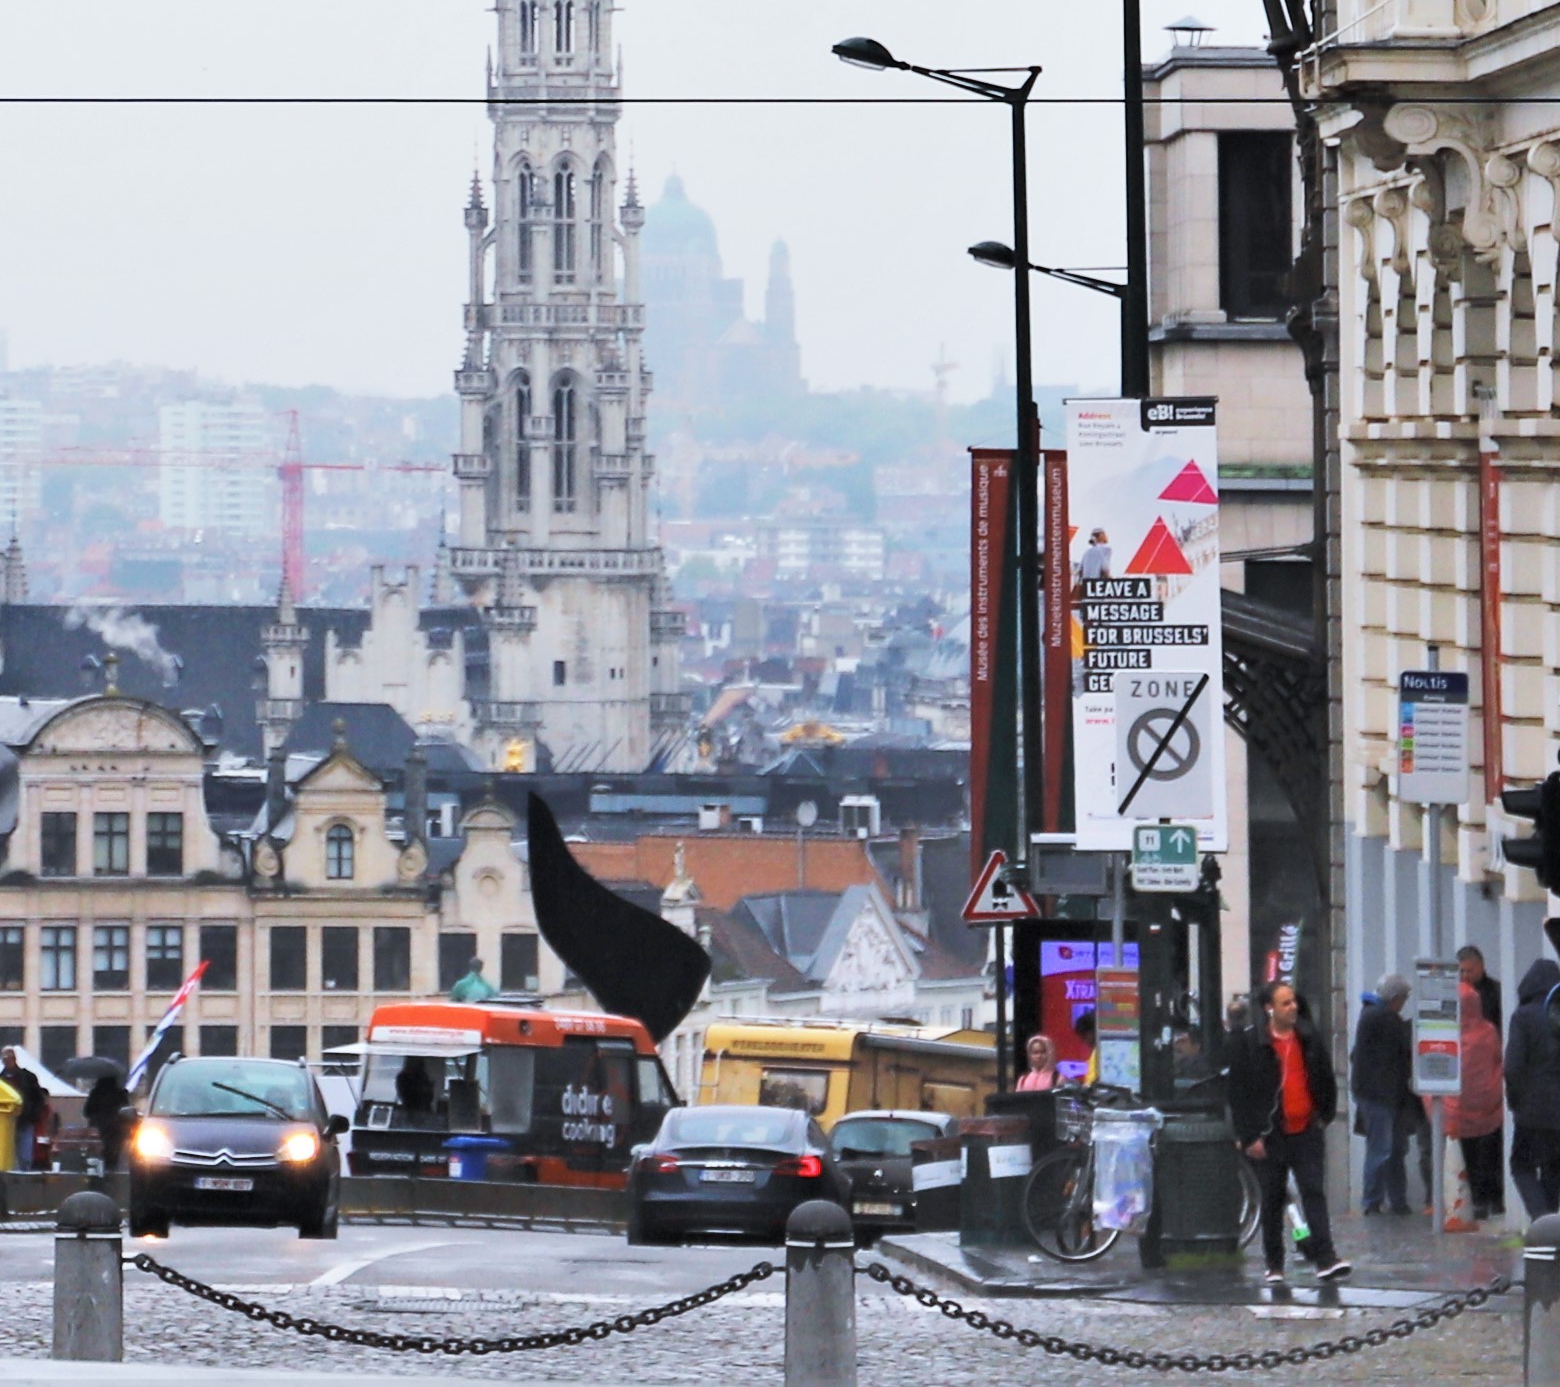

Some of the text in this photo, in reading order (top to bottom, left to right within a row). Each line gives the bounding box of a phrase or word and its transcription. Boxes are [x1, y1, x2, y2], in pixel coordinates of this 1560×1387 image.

[978, 464, 989, 518] musique
[977, 520, 989, 537] de
[977, 539, 989, 614] instruments
[1086, 581, 1147, 597] LEAVE A
[1087, 605, 1160, 621] MESSAGE
[976, 616, 989, 639] des
[1087, 628, 1208, 644] FOR BRUSSELS'
[1088, 651, 1147, 668] FUTURE
[1130, 680, 1195, 698] ZONE
